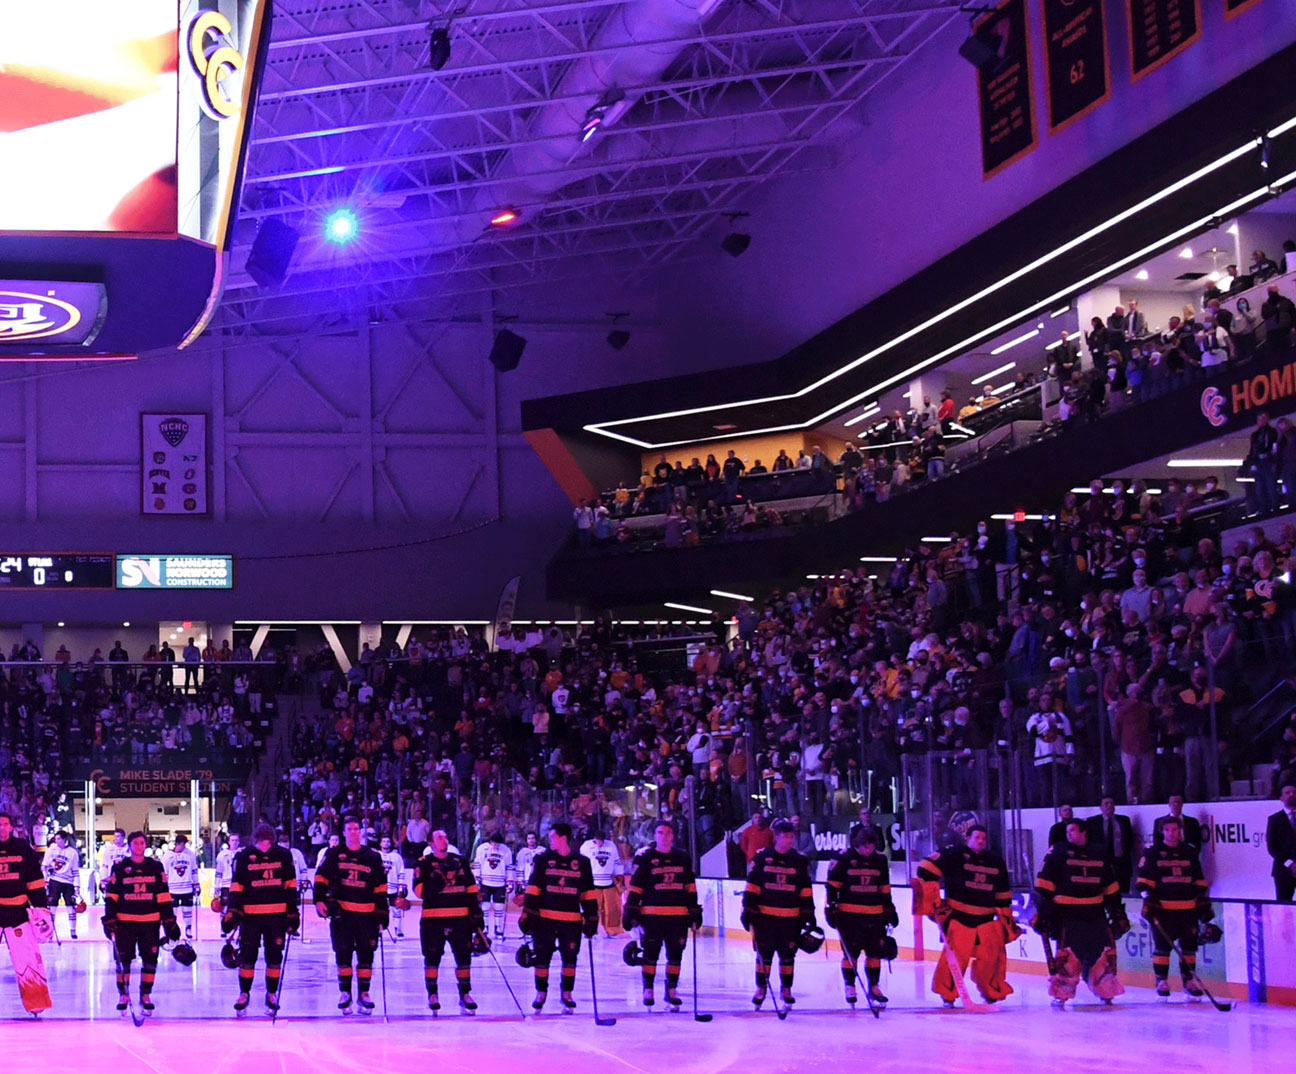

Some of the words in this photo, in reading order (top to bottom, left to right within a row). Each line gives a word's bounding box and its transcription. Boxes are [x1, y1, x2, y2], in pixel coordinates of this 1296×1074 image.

[1070, 60, 1085, 84] 62
[1232, 362, 1296, 413] HOM
[34, 568, 45, 585] 0
[166, 578, 226, 586] CONSTRUCTION
[120, 771, 150, 780] MIKE
[153, 771, 192, 780] SLADE
[195, 770, 213, 780] '79
[120, 783, 175, 793] STUDENT
[179, 783, 231, 793] SETION
[263, 869, 273, 879] 41
